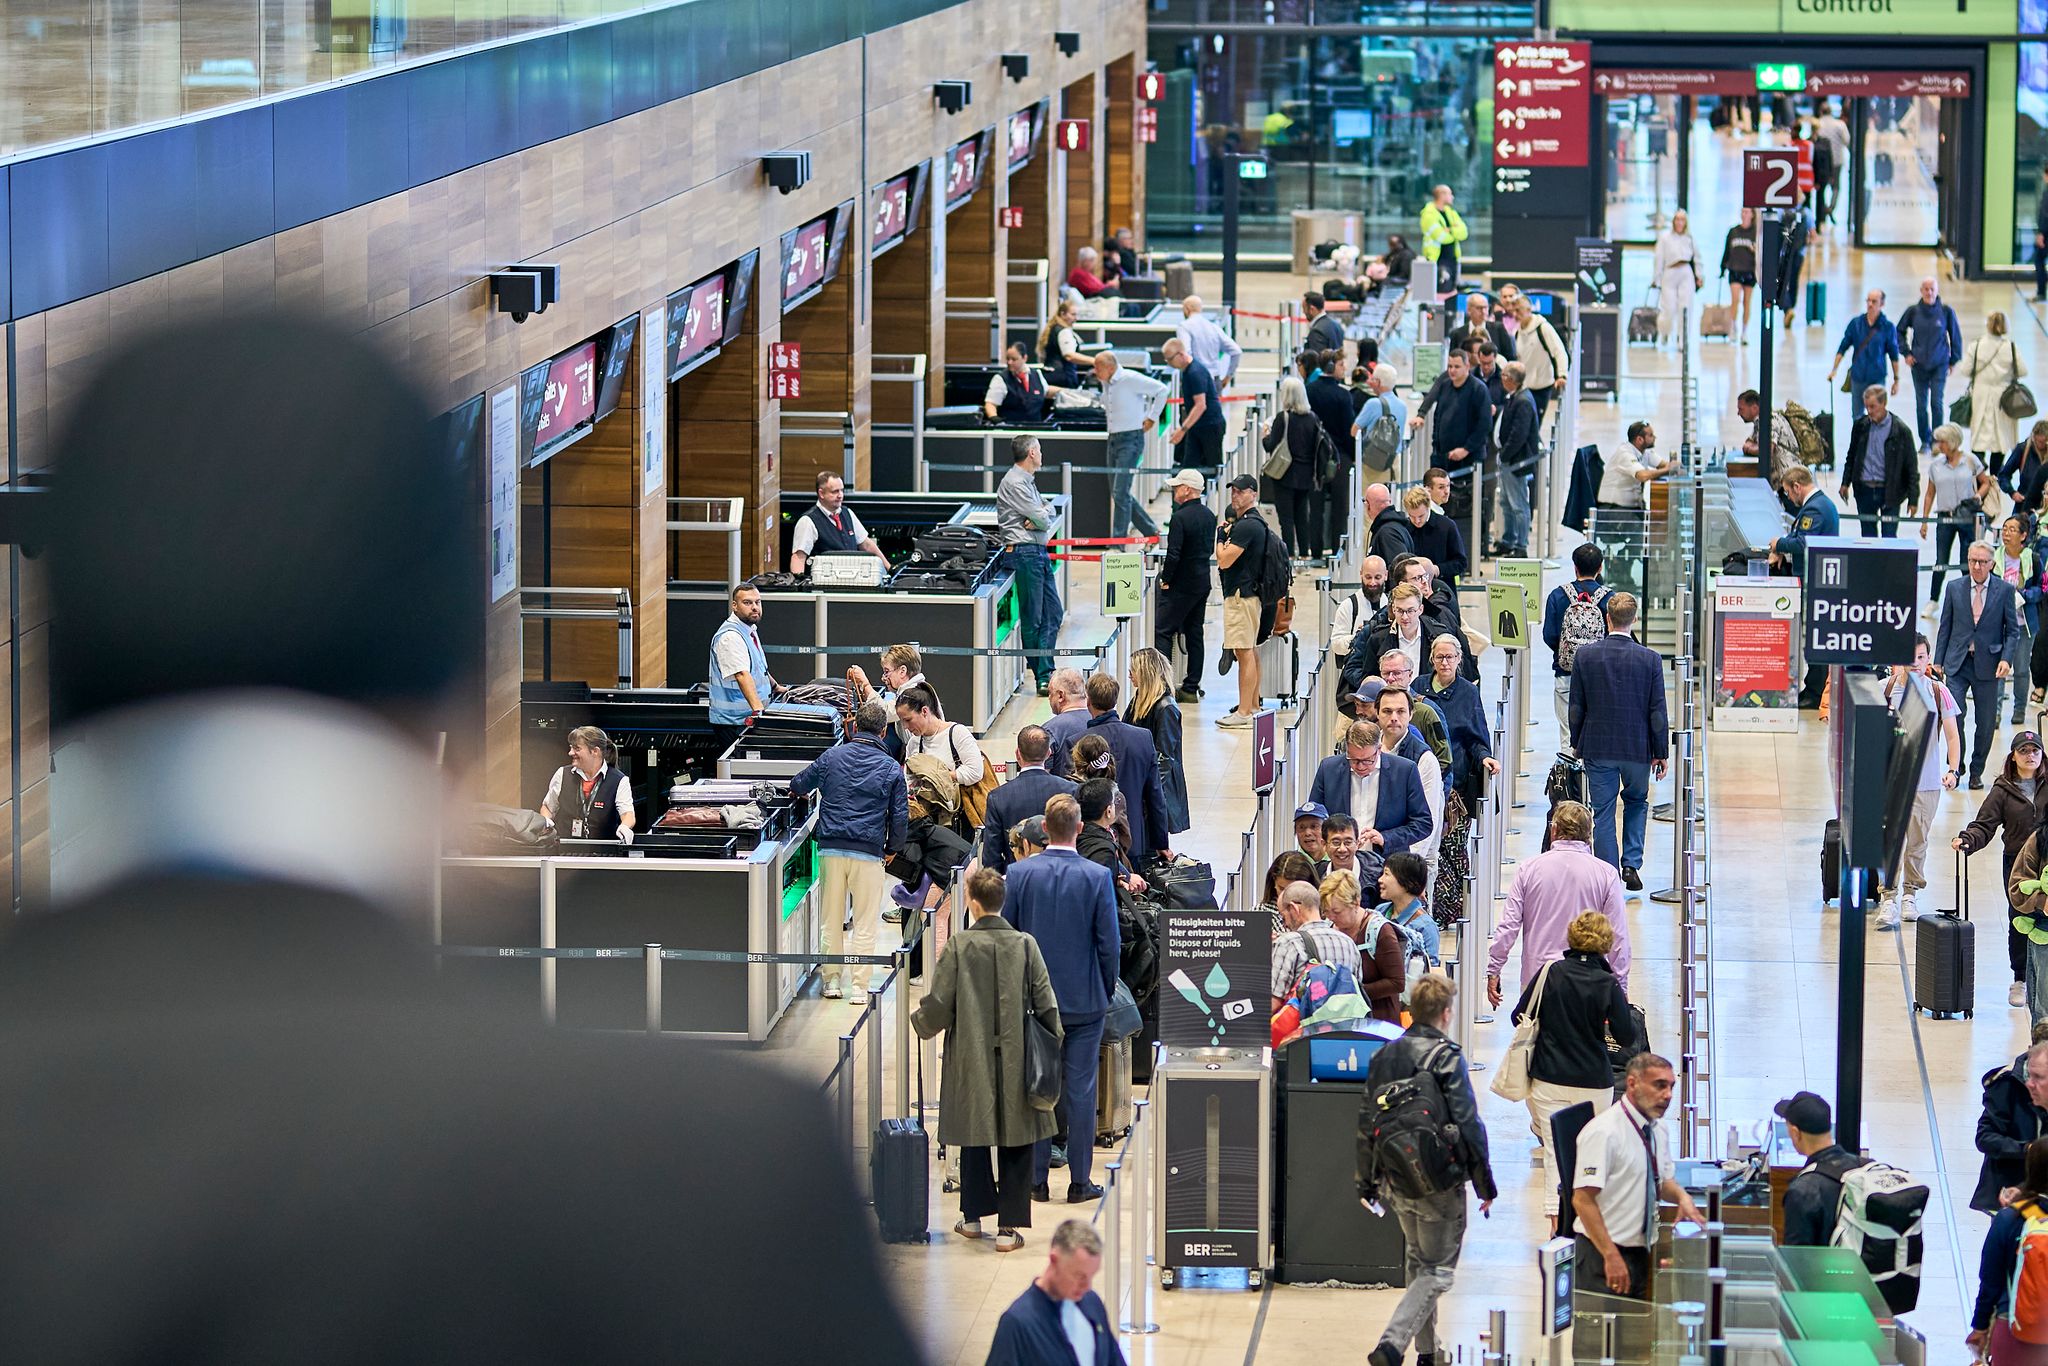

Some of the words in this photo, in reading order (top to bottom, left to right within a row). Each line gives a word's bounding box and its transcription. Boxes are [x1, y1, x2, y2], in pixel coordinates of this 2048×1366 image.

[1765, 159, 1793, 204] 2
[1721, 596, 1743, 606] BER
[1813, 599, 1911, 630] Priority
[1812, 628, 1873, 651] Lane
[1169, 918, 1224, 928] Flüssigkeiten
[1225, 918, 1246, 926] bitte
[1169, 928, 1187, 937] hier
[1188, 929, 1233, 938] entsorgen!
[1169, 939, 1201, 948] Dispose
[1202, 939, 1211, 947] of
[1214, 939, 1242, 948] liquids
[499, 948, 515, 956] BER
[596, 949, 611, 957] BER
[748, 954, 762, 962] BER
[1169, 949, 1191, 958] here,
[1192, 949, 1221, 959] please!
[1184, 1243, 1210, 1256] BER
